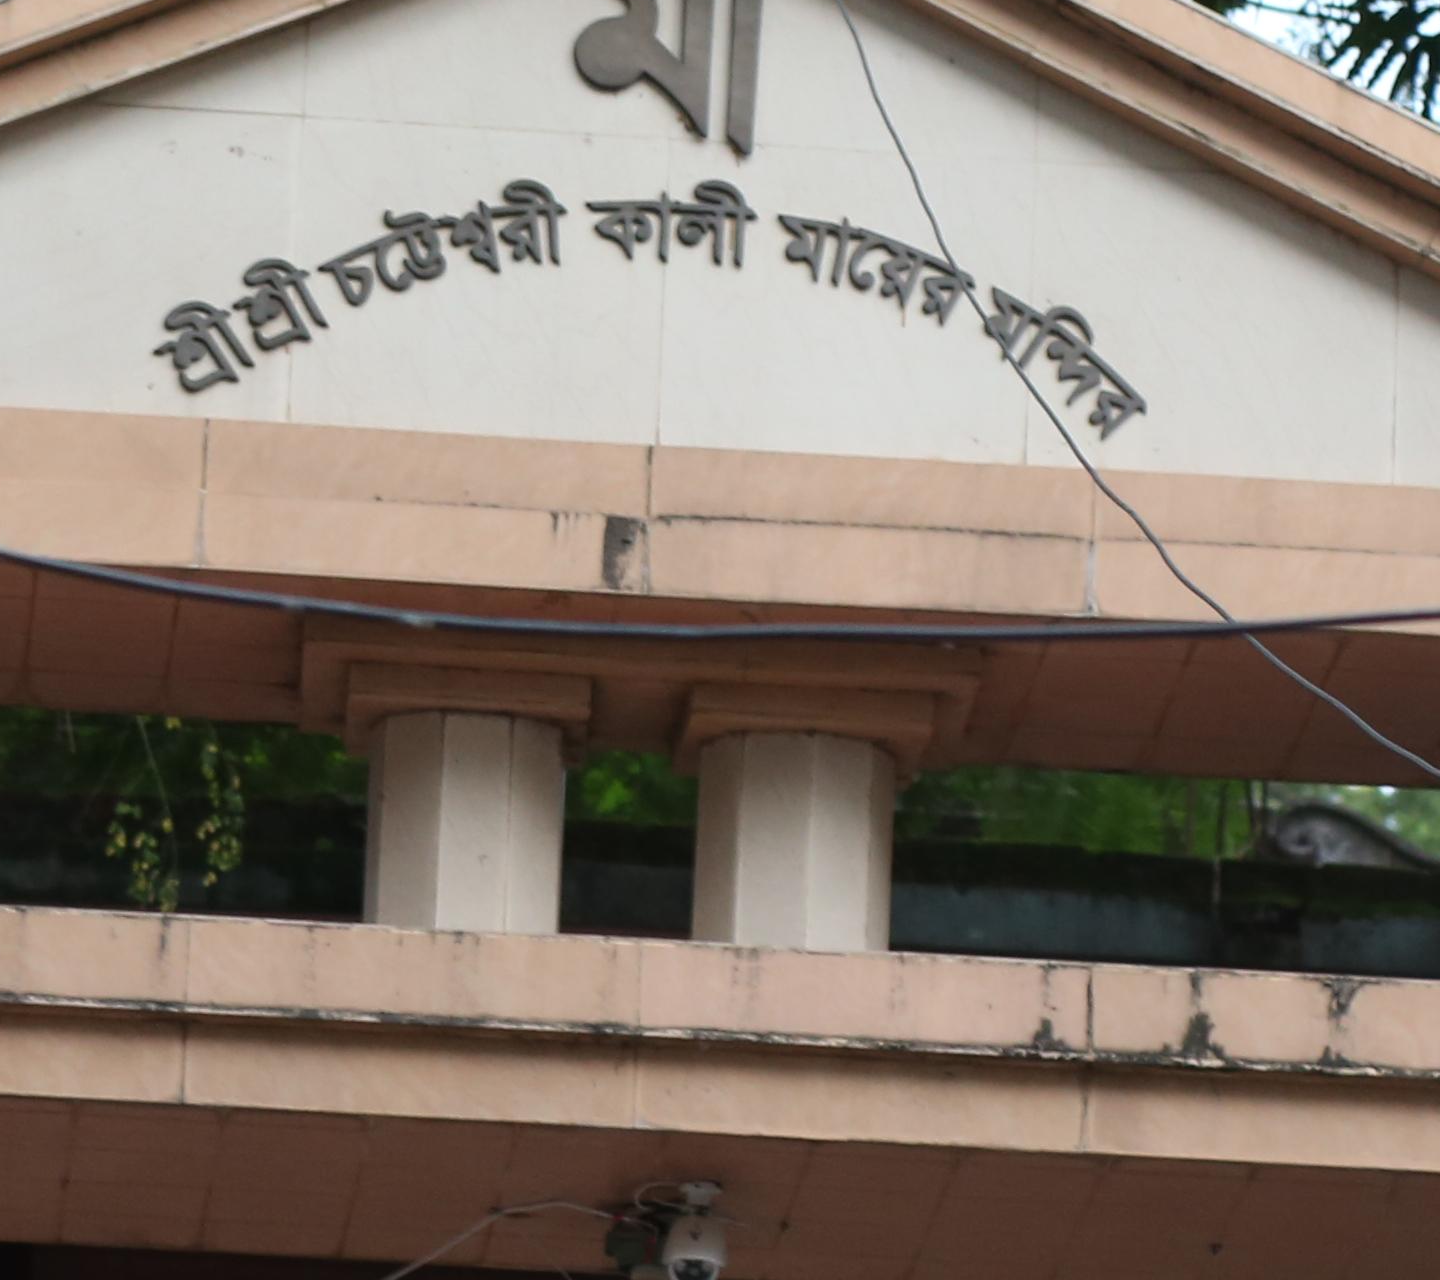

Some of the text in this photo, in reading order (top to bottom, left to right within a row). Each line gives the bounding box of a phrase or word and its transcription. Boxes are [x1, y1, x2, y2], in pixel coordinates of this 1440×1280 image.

[318, 178, 568, 307] চট্টেশ্বরী
[586, 180, 759, 269] কালী
[778, 214, 975, 327] মায়ের
[984, 286, 1148, 441] মন্দির
